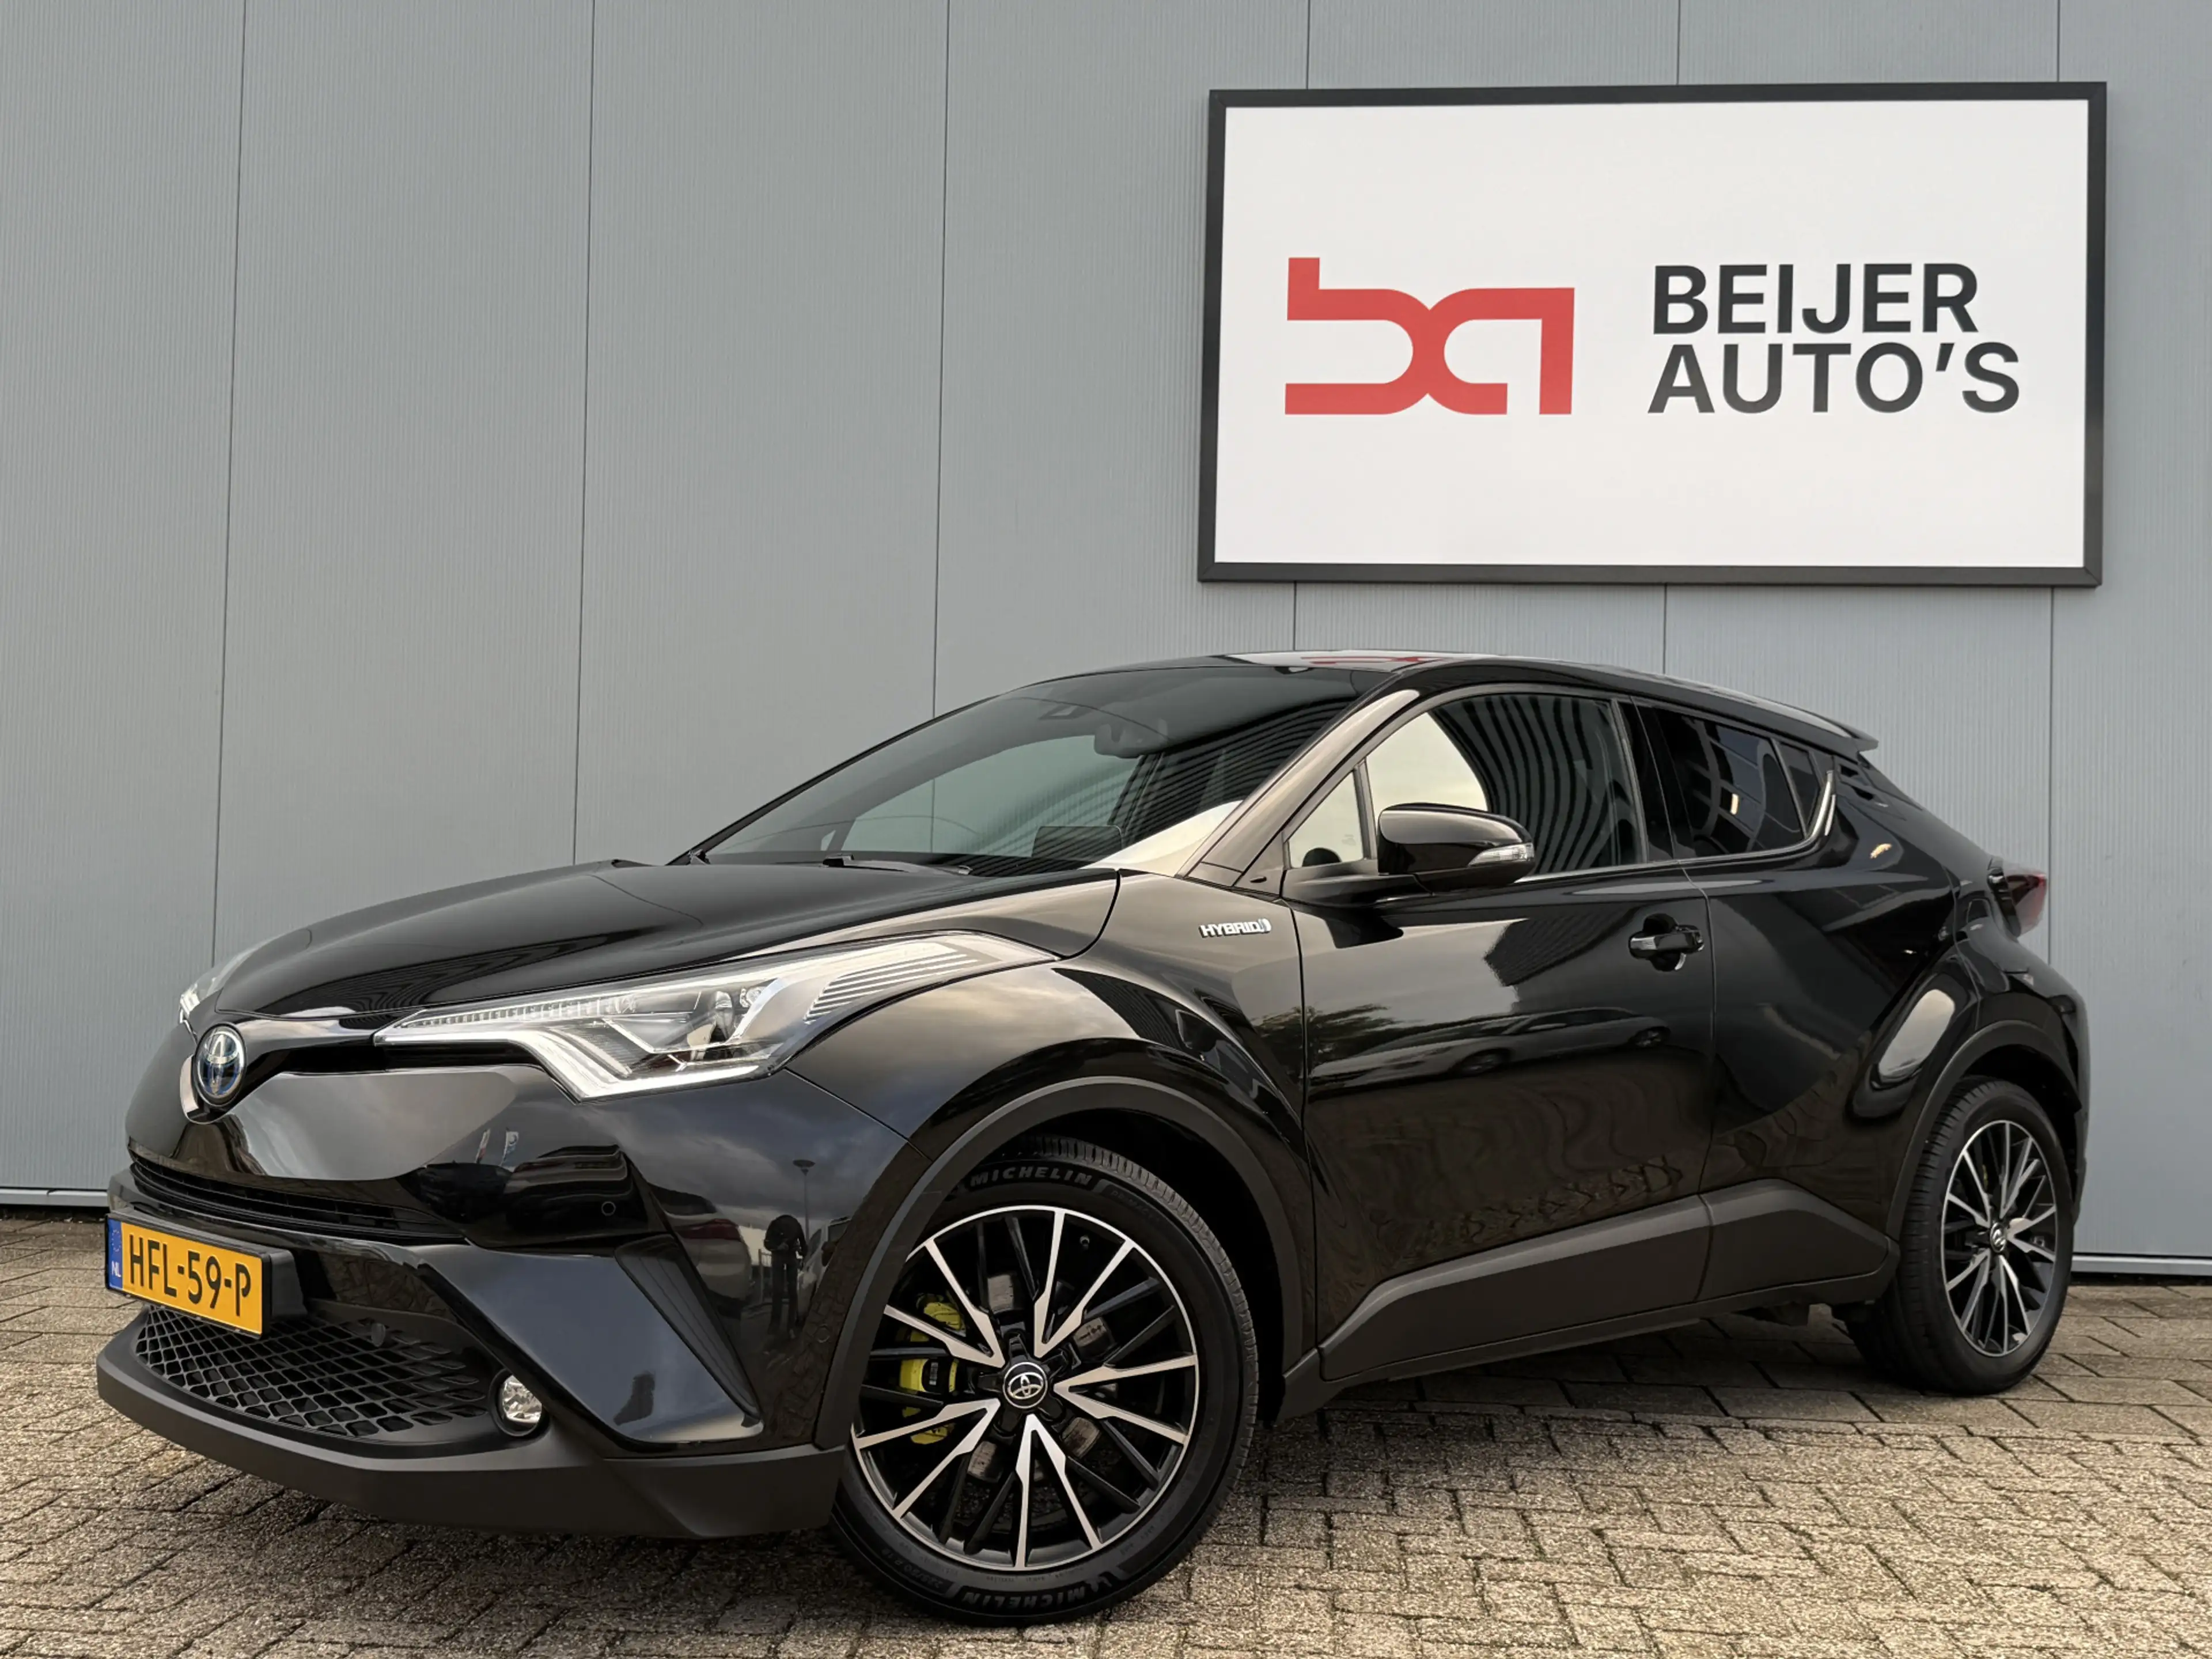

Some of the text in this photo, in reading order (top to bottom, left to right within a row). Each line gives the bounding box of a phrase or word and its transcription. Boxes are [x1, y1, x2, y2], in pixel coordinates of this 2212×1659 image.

[1654, 264, 1978, 334] BEIJER
[1649, 342, 2018, 413] AUTO'S
[1200, 921, 1262, 937] HYBRID
[970, 1166, 1093, 1187] MICHELIN
[112, 1260, 122, 1277] NL
[130, 1234, 251, 1317] HFL-59-P
[963, 1586, 1085, 1608] MICHELIN
